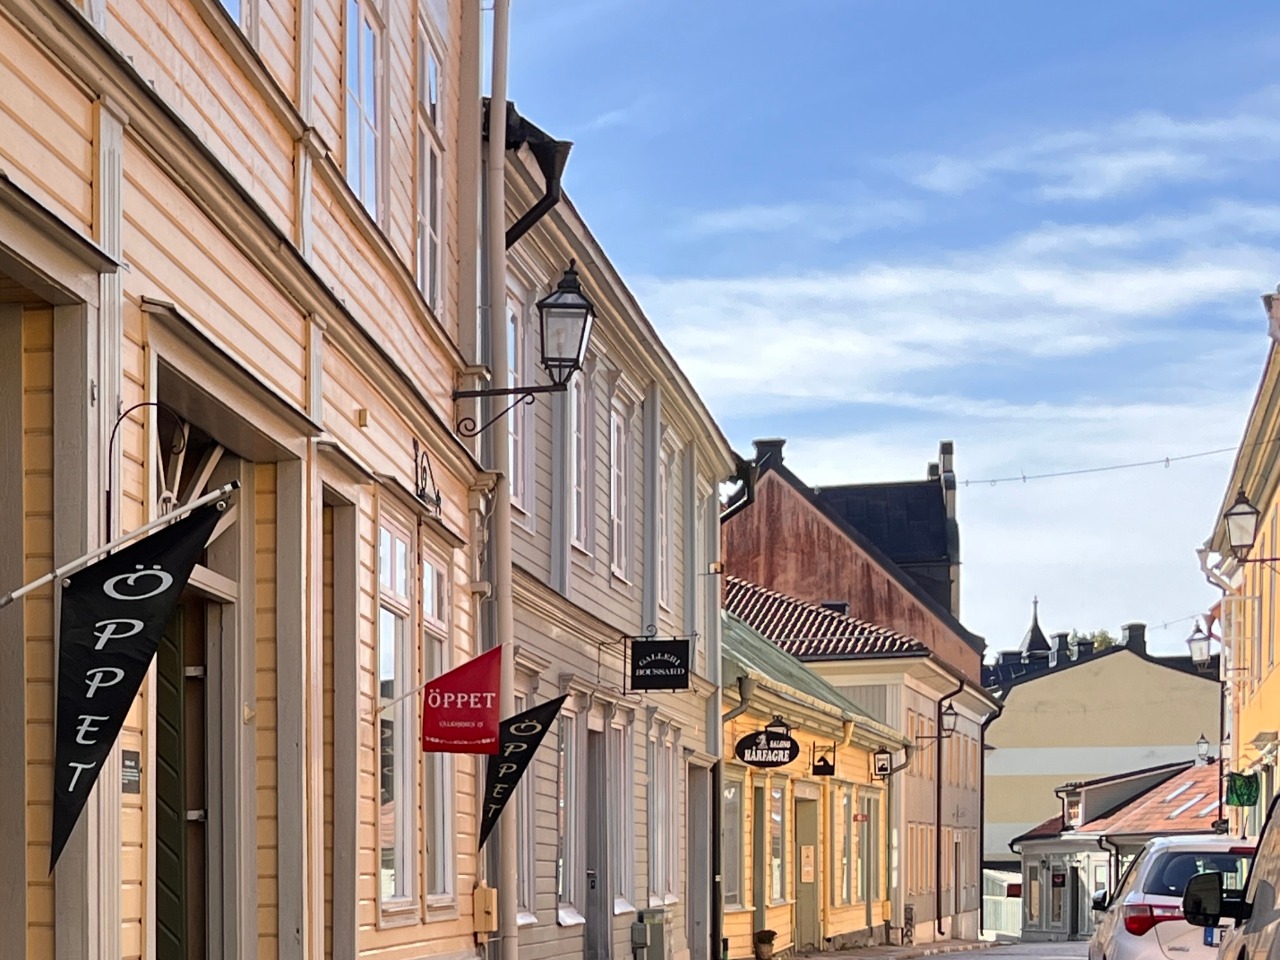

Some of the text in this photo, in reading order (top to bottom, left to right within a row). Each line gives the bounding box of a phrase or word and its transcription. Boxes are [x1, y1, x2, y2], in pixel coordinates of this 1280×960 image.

[638, 652, 681, 667] GALLERI
[67, 563, 174, 793] ÖPPET
[428, 688, 496, 709] ÖPPET
[744, 745, 790, 762] HÅRFAGRE
[770, 740, 791, 749] SALONG
[488, 718, 543, 819] ÖPPET
